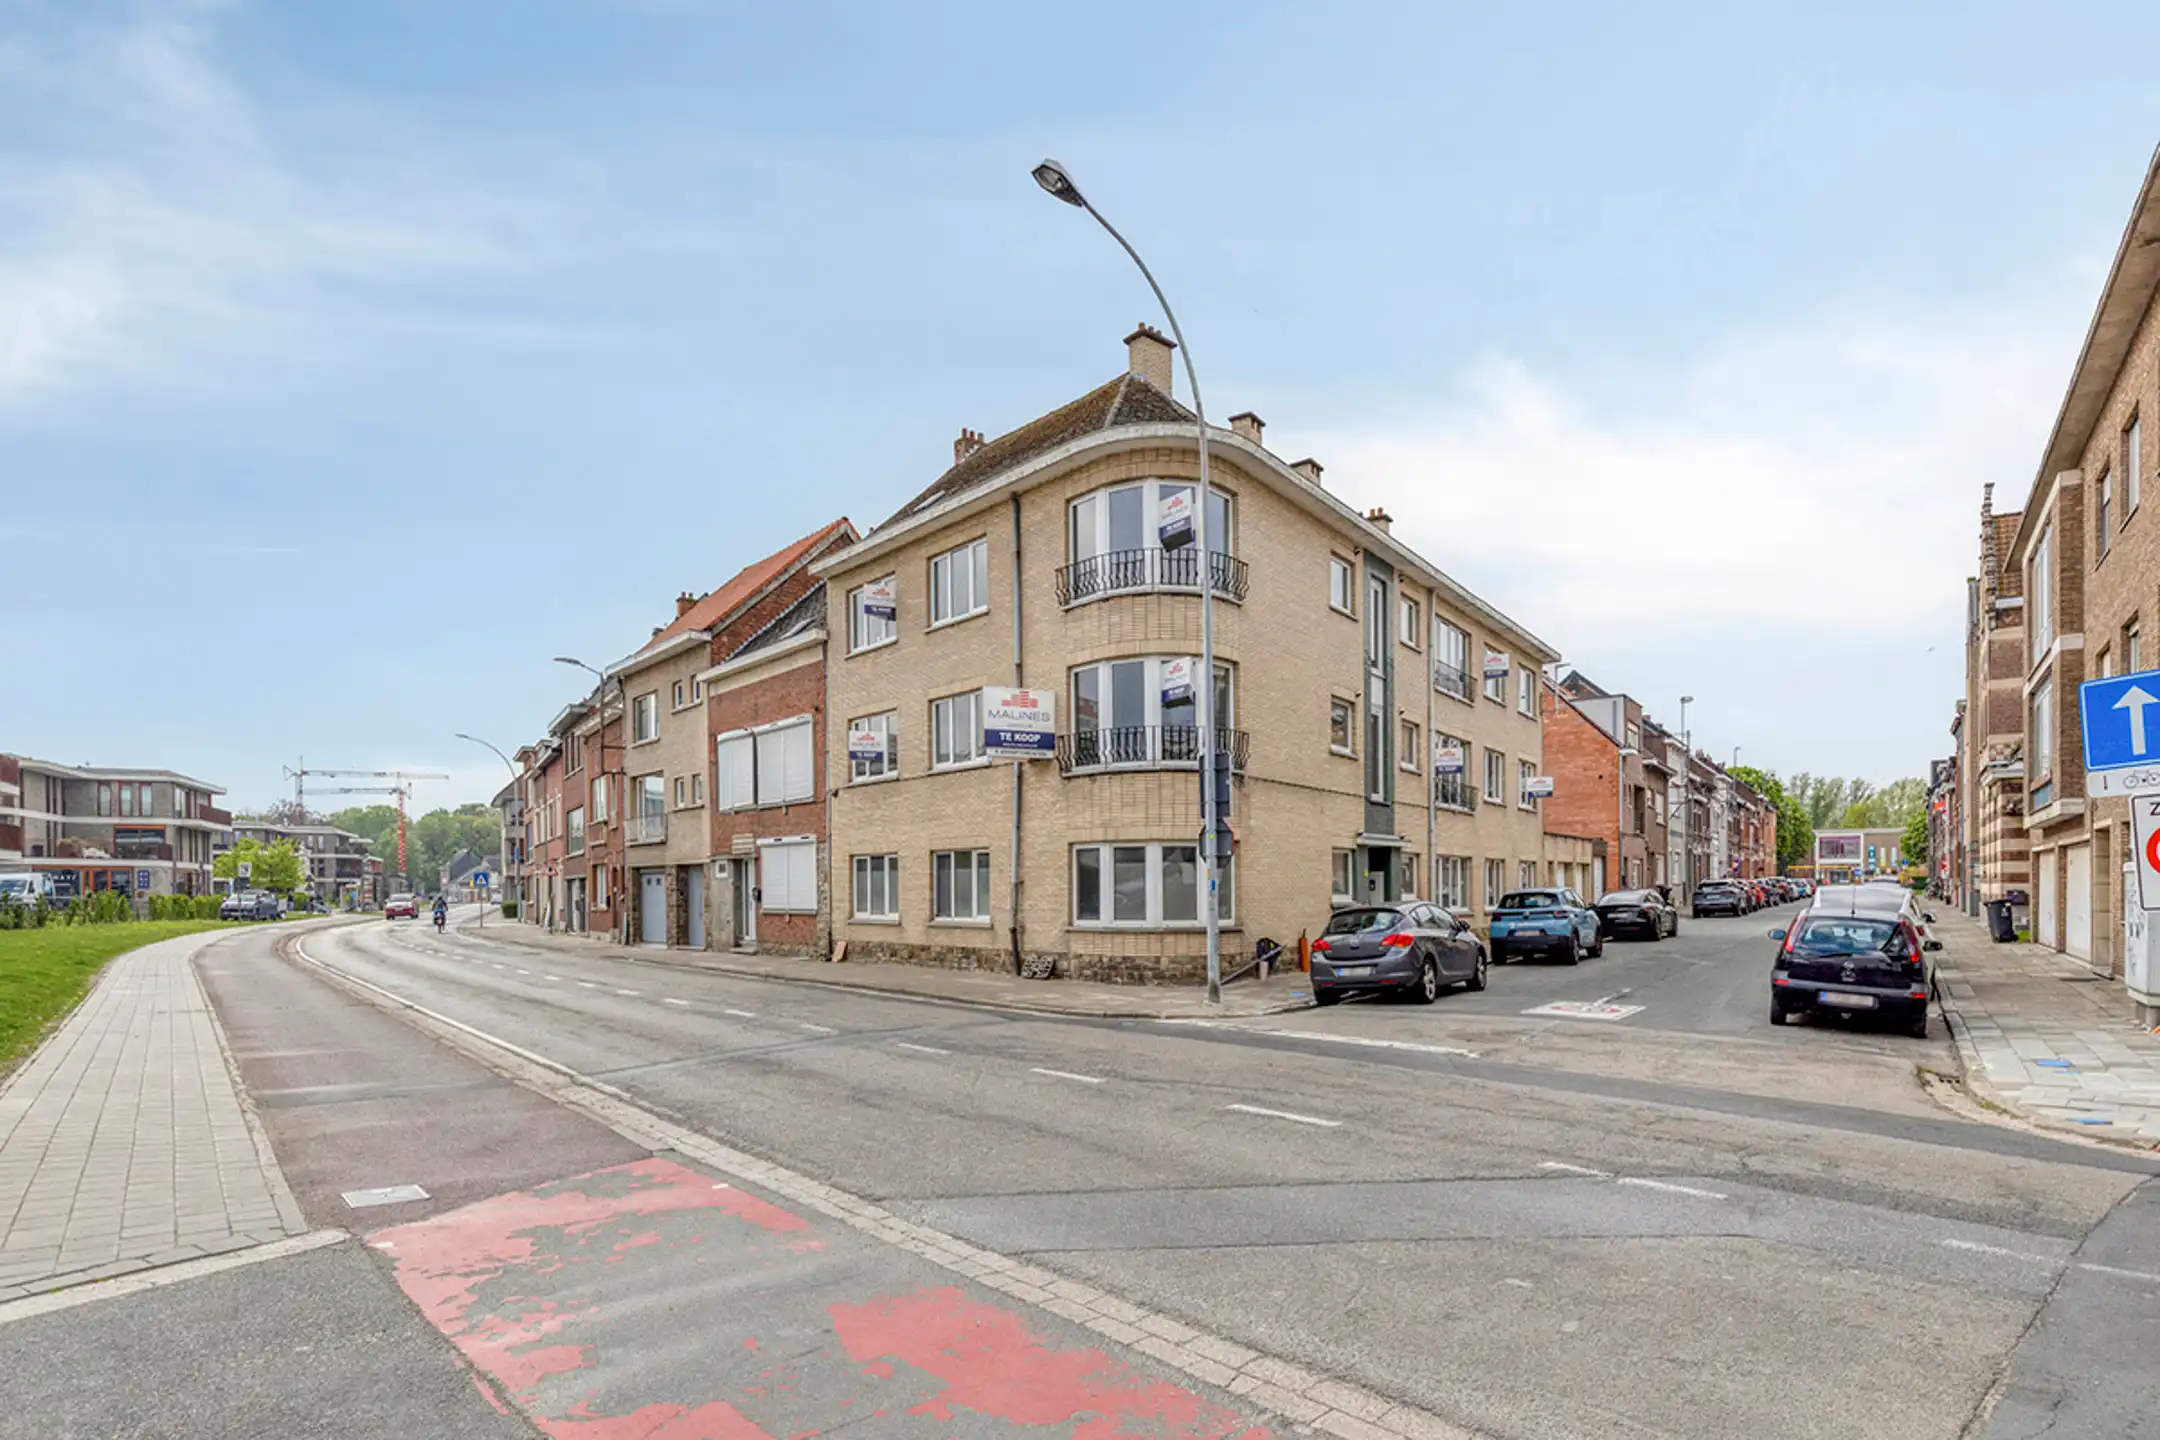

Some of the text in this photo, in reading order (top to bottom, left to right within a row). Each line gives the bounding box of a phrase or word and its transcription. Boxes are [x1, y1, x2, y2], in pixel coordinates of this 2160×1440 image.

[987, 708, 1051, 722] MALINES
[999, 731, 1041, 743] TE KOOP
